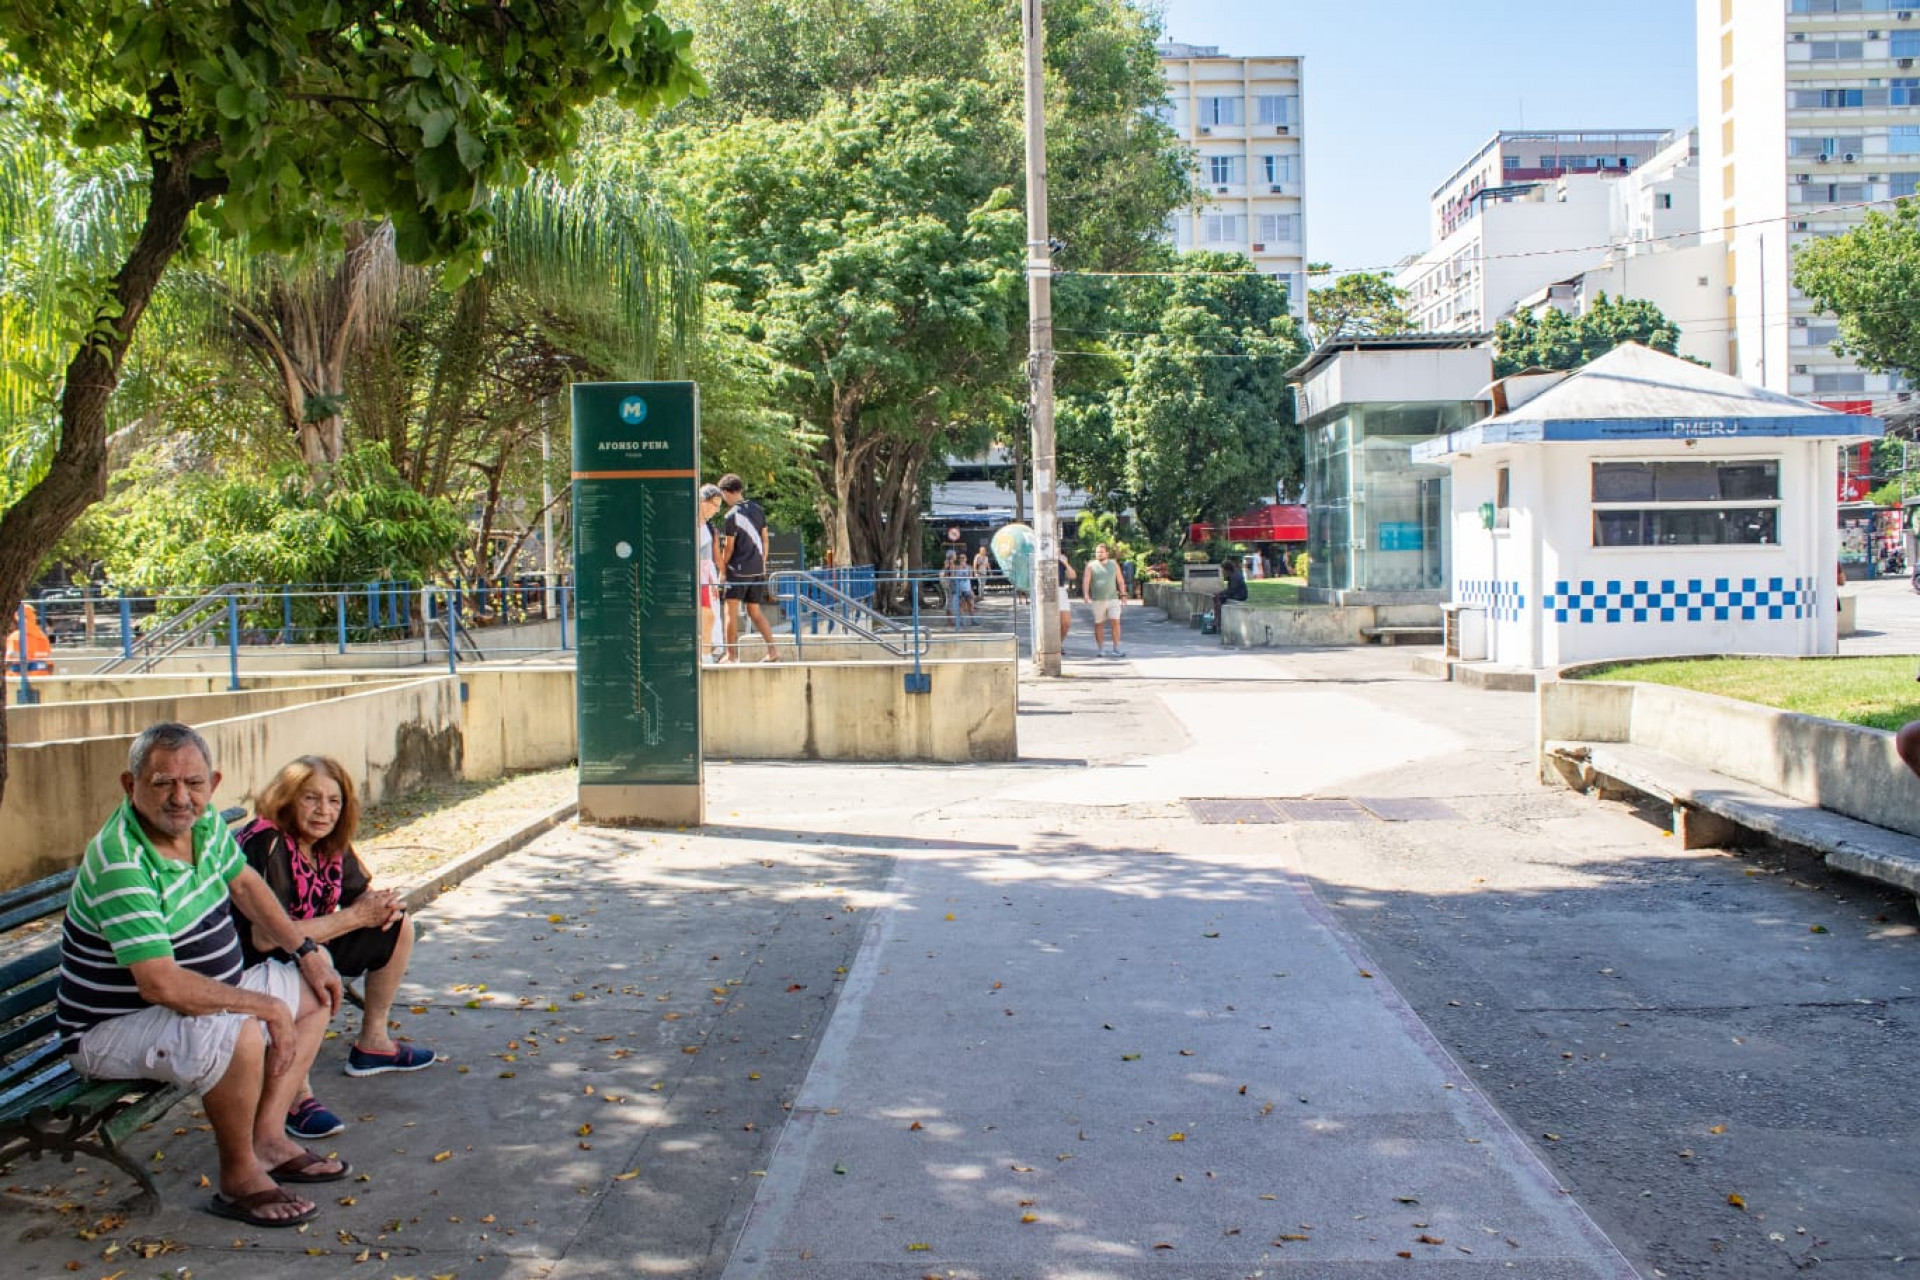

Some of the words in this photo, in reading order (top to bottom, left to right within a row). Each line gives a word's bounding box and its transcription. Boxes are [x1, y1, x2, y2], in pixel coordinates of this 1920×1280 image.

[622, 402, 641, 418] M
[1673, 421, 1738, 436] PMERJ
[598, 441, 639, 450] AFONSO
[642, 441, 669, 450] PENA
